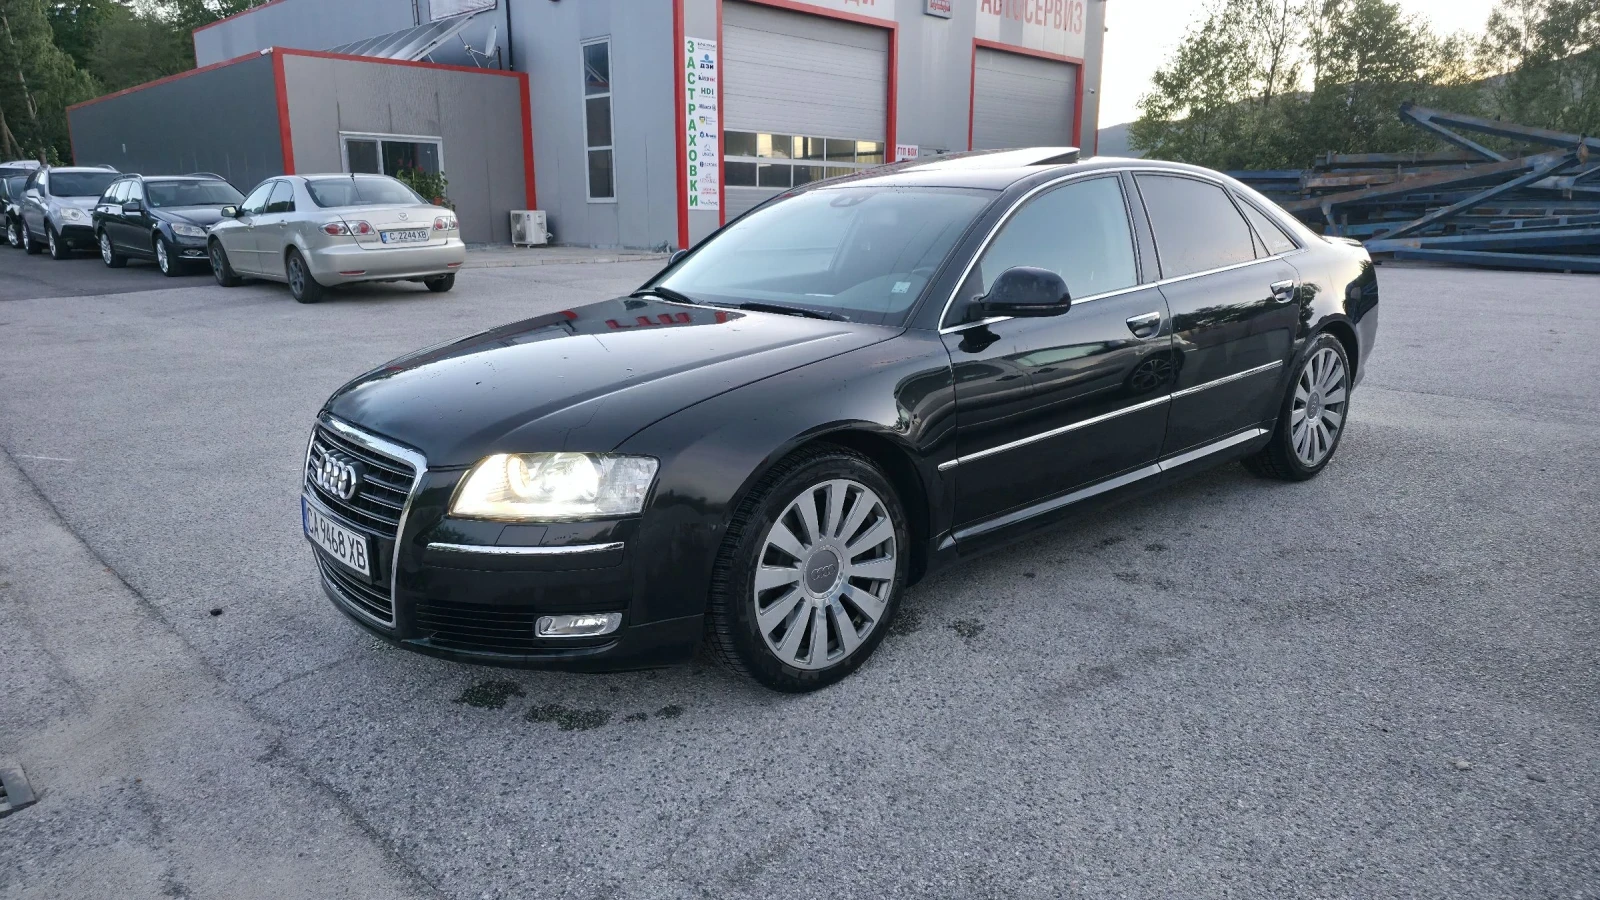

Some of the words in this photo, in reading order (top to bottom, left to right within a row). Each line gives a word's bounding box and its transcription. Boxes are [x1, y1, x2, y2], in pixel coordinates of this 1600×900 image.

[701, 87, 714, 96] HDI
[687, 40, 698, 207] ЗАСТРАХОВКИ
[399, 231, 416, 239] 2244
[307, 507, 319, 540] CA
[321, 518, 346, 558] 9468
[347, 535, 366, 570] XB
